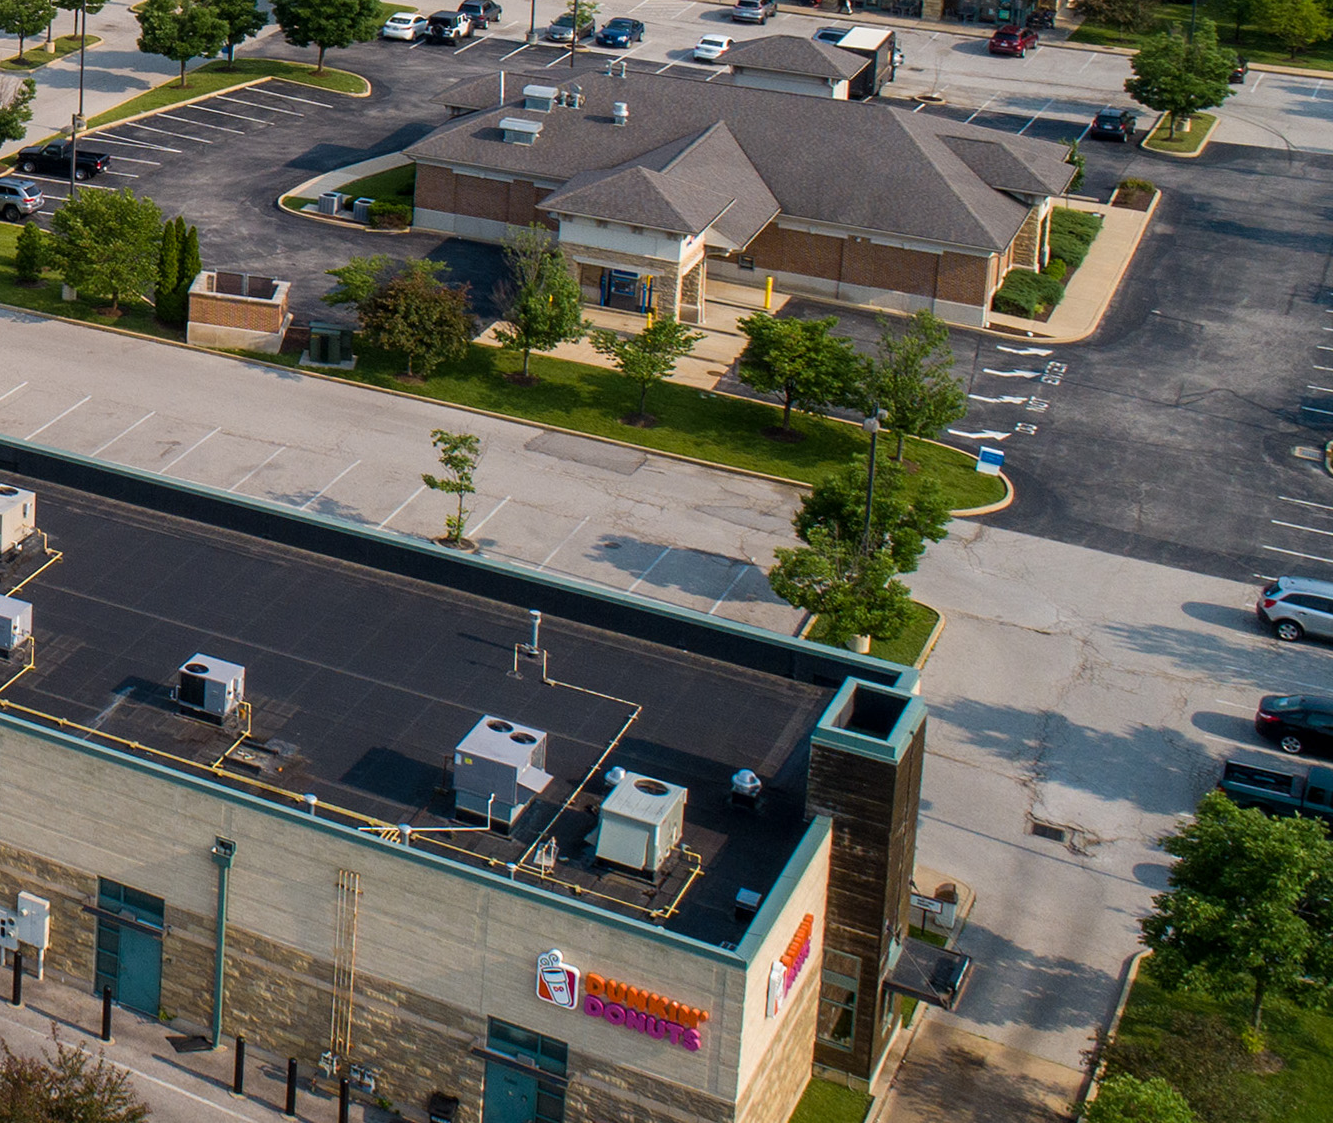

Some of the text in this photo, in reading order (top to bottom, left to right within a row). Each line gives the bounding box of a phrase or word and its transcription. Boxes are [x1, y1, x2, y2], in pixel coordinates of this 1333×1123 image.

[1015, 360, 1069, 435] DO NOT ENTER
[583, 994, 702, 1052] DONUTS
[585, 971, 710, 1028] DUNKIN'
